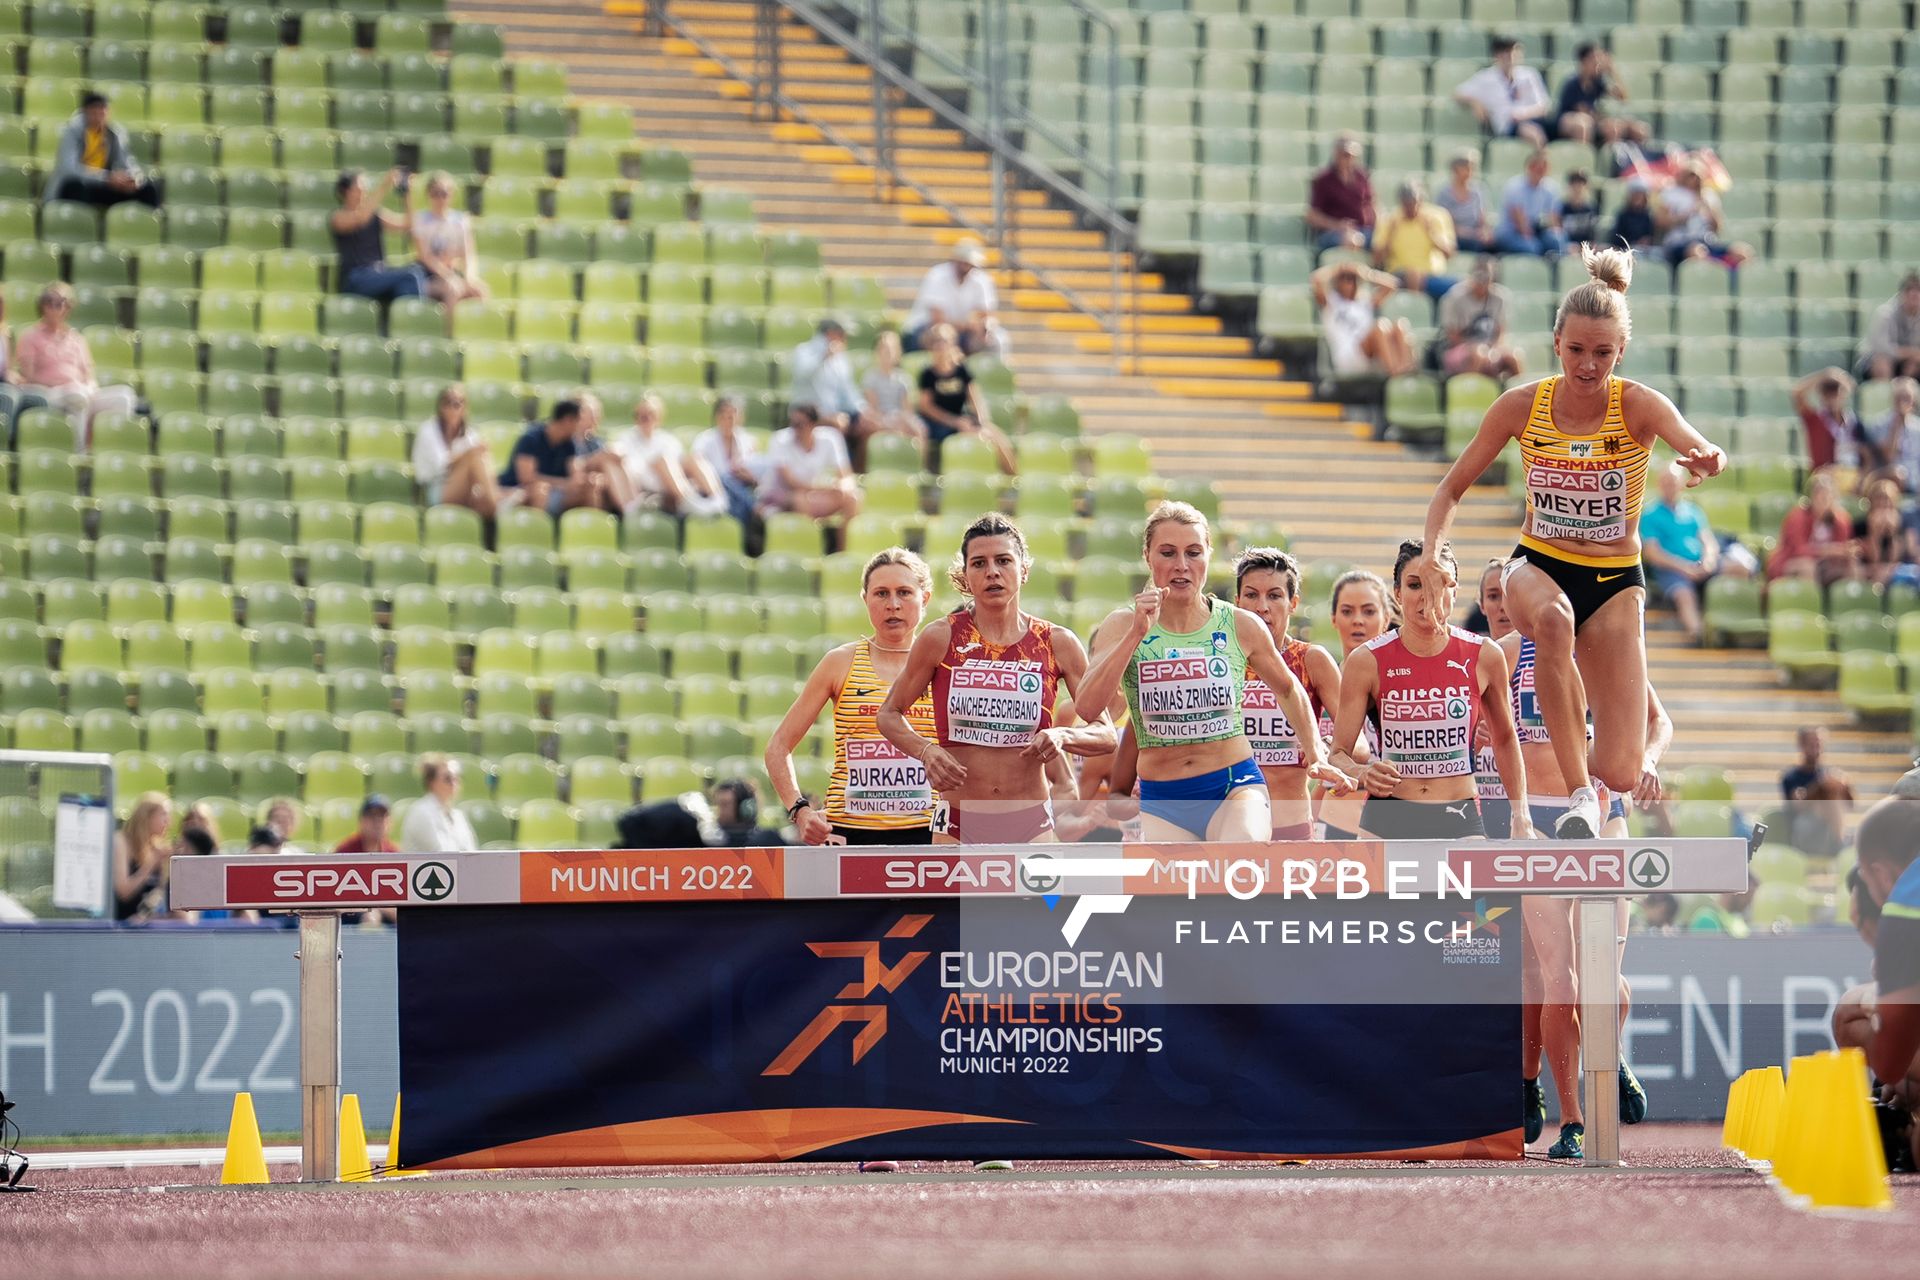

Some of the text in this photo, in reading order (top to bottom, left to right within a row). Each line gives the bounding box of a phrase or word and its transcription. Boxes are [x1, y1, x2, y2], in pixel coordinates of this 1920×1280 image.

[1571, 443, 1591, 457] wgv
[1533, 456, 1621, 471] GERMANY
[1531, 470, 1598, 489] SPAR
[1533, 492, 1623, 517] MEYER
[1555, 517, 1574, 527] RUN
[1536, 522, 1620, 540] MUNICH 2022
[1141, 661, 1206, 680] SPAR
[1395, 668, 1412, 676] UBS
[954, 671, 1017, 689] SPAR
[1142, 682, 1233, 712] MIŠMAŠ ZRIMŠEK
[1241, 692, 1276, 707] AR
[859, 705, 933, 718] GEANY
[949, 692, 1038, 721] SÁNCHEZ-ESCRIBANO
[1384, 703, 1445, 719] SPAR
[1168, 714, 1185, 722] RUN
[1186, 713, 1212, 721] CLEAN
[991, 723, 1017, 731] CLEAN
[1149, 719, 1229, 736] MUNICH 2022
[1244, 717, 1296, 737] BLES
[954, 728, 1029, 744] MUNICH 2022
[1384, 726, 1467, 749] SCHERRER
[1265, 751, 1293, 762] 2022
[1396, 761, 1466, 775] UNICH 2022
[849, 767, 927, 787] BURKARD
[850, 800, 927, 811] MUNICH 2022
[885, 860, 1012, 888] SPAR
[1493, 854, 1621, 882] SPAR
[273, 868, 404, 897] SPAR
[551, 864, 753, 892] MUNICH 2022
[1442, 938, 1500, 948] EUROPEAN
[1442, 948, 1500, 956] CHAMPIONSHIPS
[1443, 956, 1500, 964] MUNICH 2022
[940, 951, 1163, 988] EUROPEAN
[940, 993, 1122, 1024] ATHLETICS
[88, 987, 299, 1096] 2022
[940, 1027, 1163, 1053] CHAMPIONSHIPS
[940, 1057, 1069, 1074] MUNICH 2022
